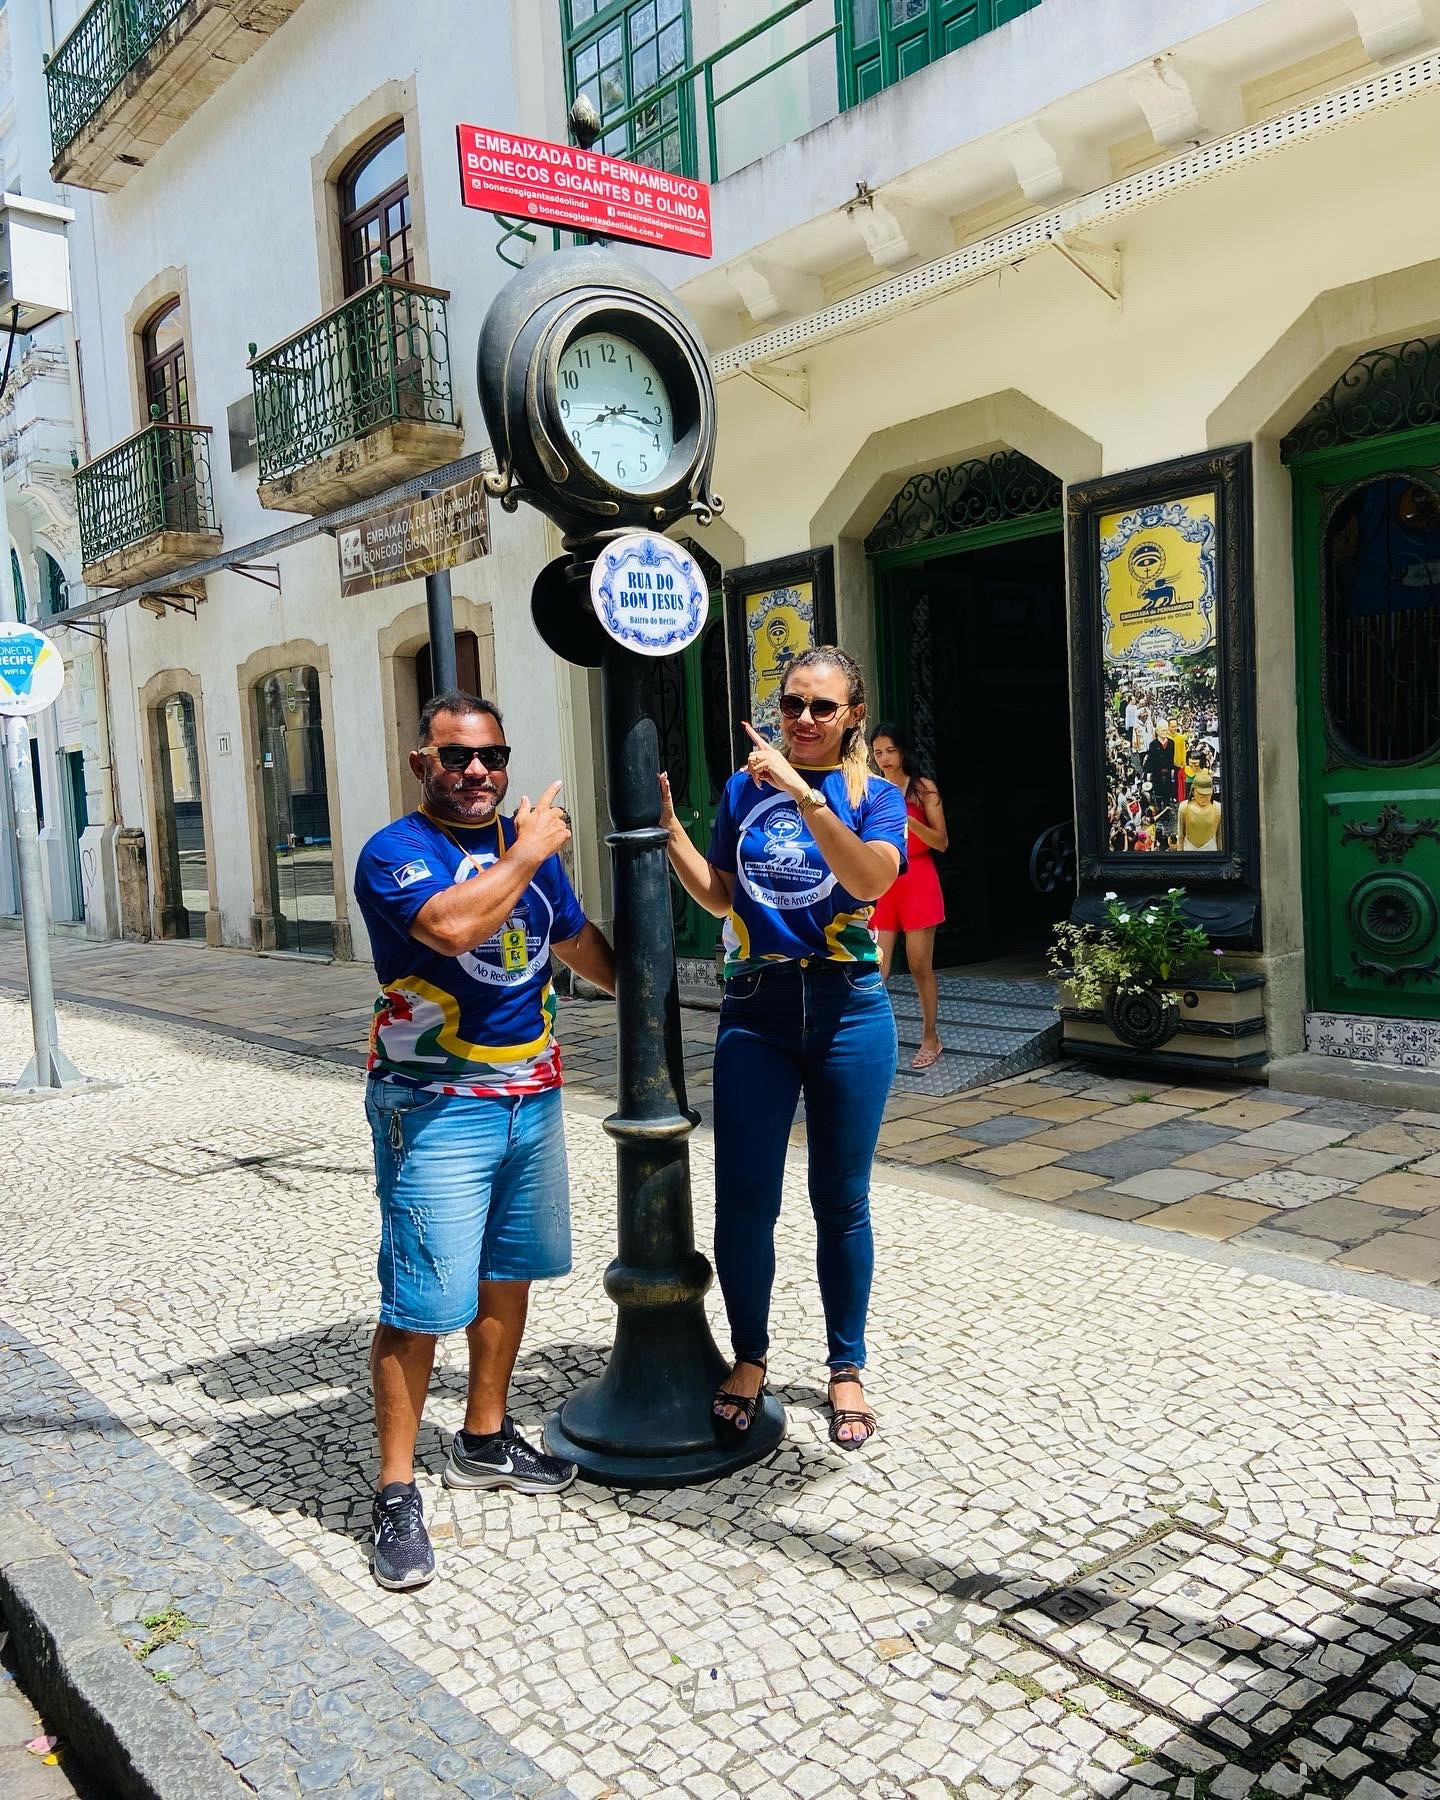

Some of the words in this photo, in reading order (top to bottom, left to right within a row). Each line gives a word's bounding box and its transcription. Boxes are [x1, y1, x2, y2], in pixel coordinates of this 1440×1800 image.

[474, 132, 573, 168] EMBAIXADA
[575, 154, 597, 174] DE
[600, 160, 699, 200] PERNAMBUCO
[467, 152, 550, 184] BONECOS
[554, 171, 631, 203] GIGANTES
[634, 190, 654, 209] DE
[656, 197, 707, 223] OLINDA
[483, 180, 589, 210] bonecosgigantesdeolinda
[539, 205, 664, 240] bonecosgigantesdeolinda.com.br
[616, 210, 706, 238] embaixadadepernambuco
[575, 349, 591, 369] 11
[598, 343, 617, 363] 12
[625, 354, 633, 373] 1
[561, 370, 579, 390] 10
[643, 376, 654, 396] 2
[560, 399, 571, 418] 9
[654, 406, 663, 425] 3
[571, 430, 582, 449] 8
[652, 433, 661, 452] 4
[591, 450, 600, 469] 7
[617, 460, 626, 479] 6
[639, 454, 648, 472] 5
[366, 518, 414, 546] EMBAIXADA
[416, 513, 426, 530] DE
[428, 490, 480, 525] PERNAMBUCO
[363, 541, 403, 564] BONECOS
[405, 527, 444, 552] GIGANTES
[445, 522, 456, 537] DE
[457, 508, 485, 534] OLINDA
[627, 571, 653, 590] RUA
[656, 573, 674, 591] DO
[620, 591, 648, 609] BOM
[651, 593, 684, 612] JESUS
[650, 616, 658, 625] do
[0, 655, 34, 666] ECIFE
[762, 892, 790, 906] Recife
[791, 891, 819, 906] Antigo
[474, 963, 488, 978] No
